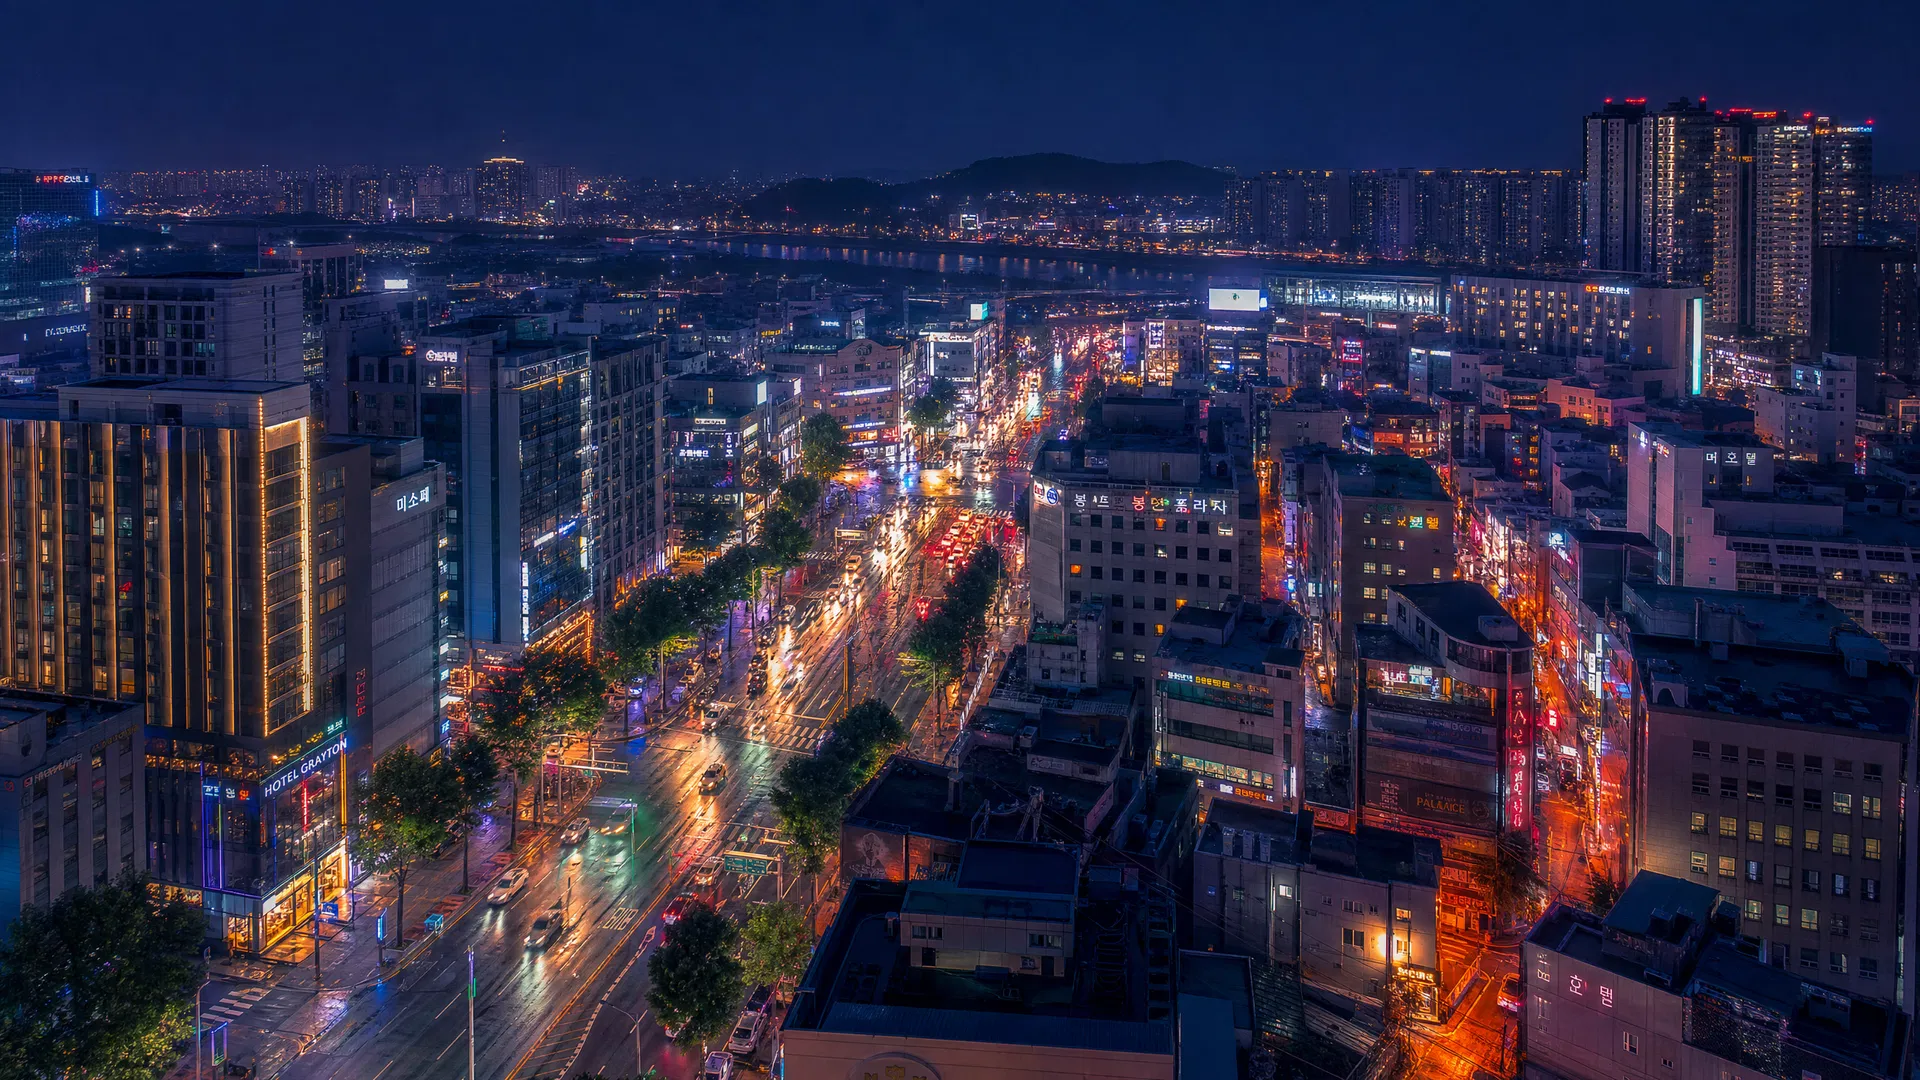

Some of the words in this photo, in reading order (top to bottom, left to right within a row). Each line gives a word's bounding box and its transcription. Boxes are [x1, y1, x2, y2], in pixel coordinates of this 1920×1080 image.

[396, 486, 430, 512] 미소페
[264, 769, 300, 798] HOTEL
[300, 737, 348, 774] GRAYTON
